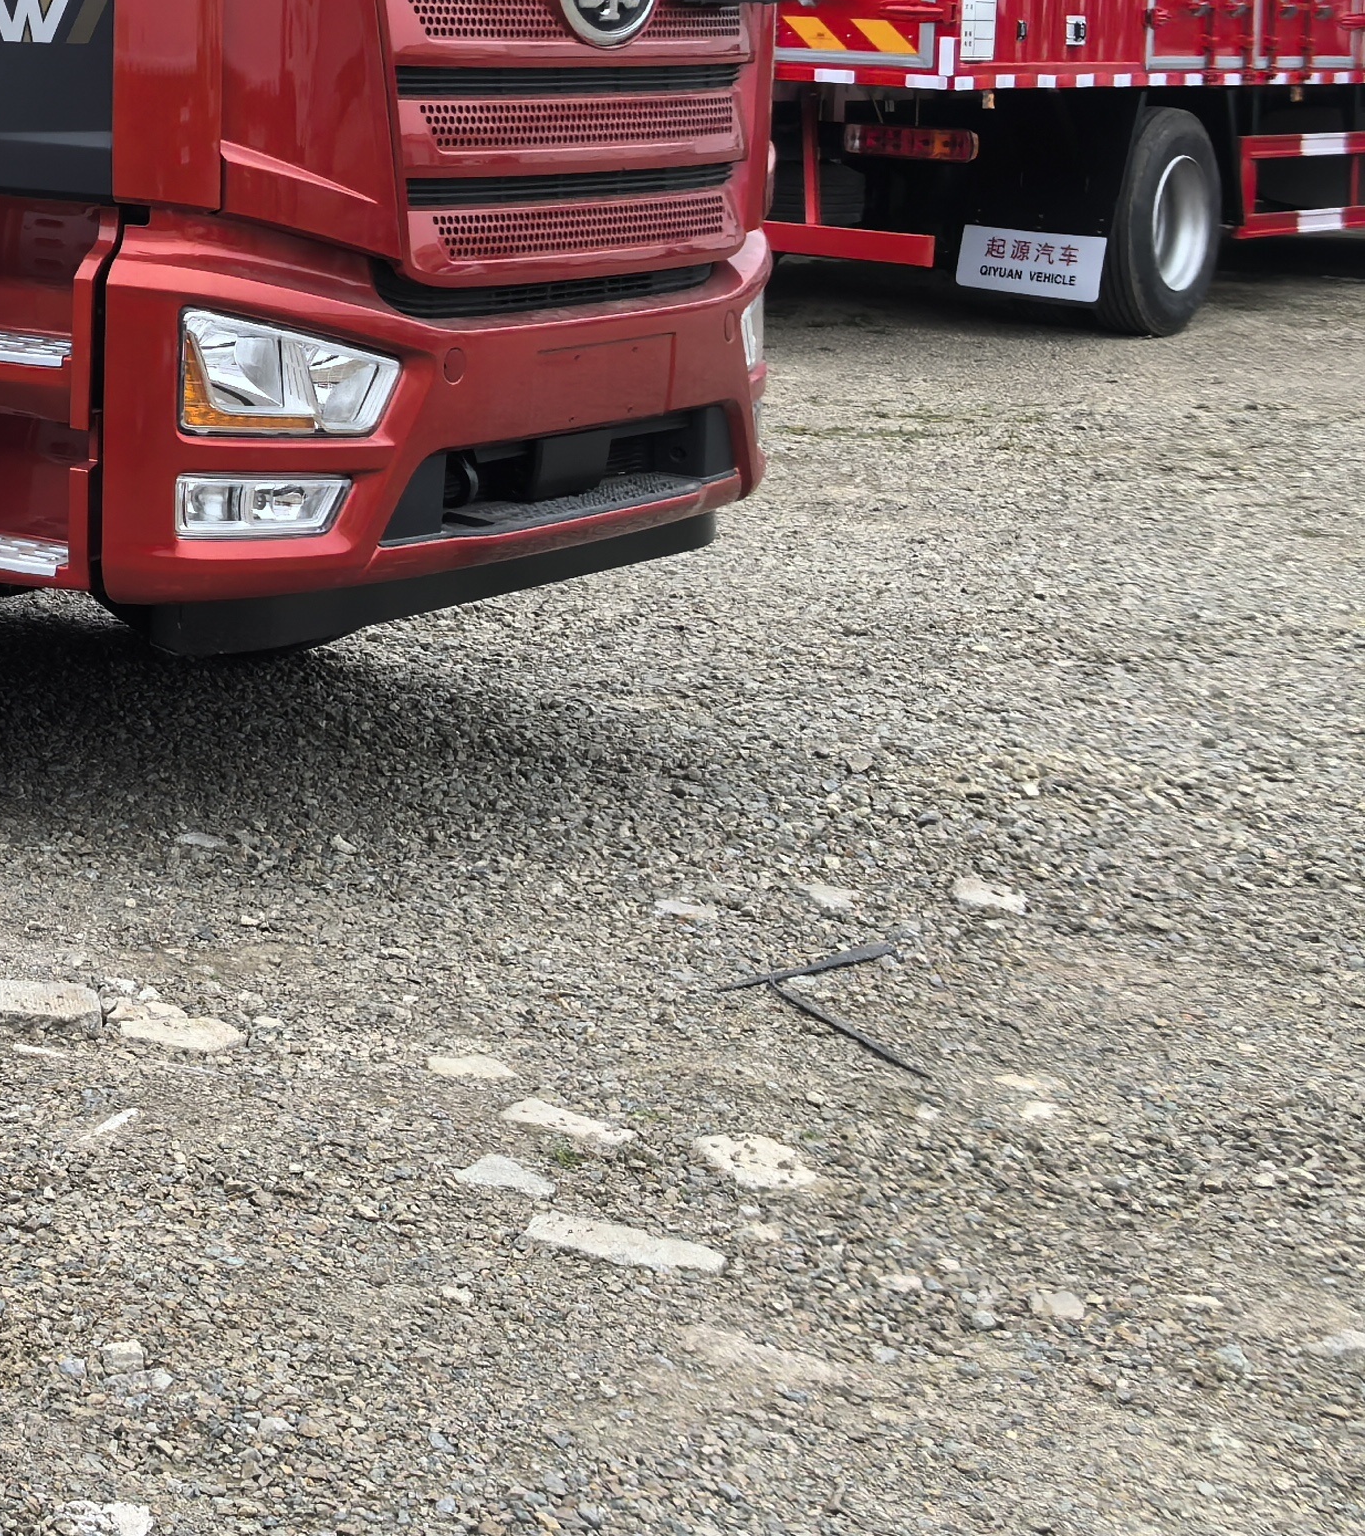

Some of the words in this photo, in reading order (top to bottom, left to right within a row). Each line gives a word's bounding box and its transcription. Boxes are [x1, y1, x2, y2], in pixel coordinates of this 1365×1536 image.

[984, 236, 1079, 267] 起源汽车
[979, 265, 1023, 280] QIYUAN
[1029, 270, 1077, 287] VEHICLE
